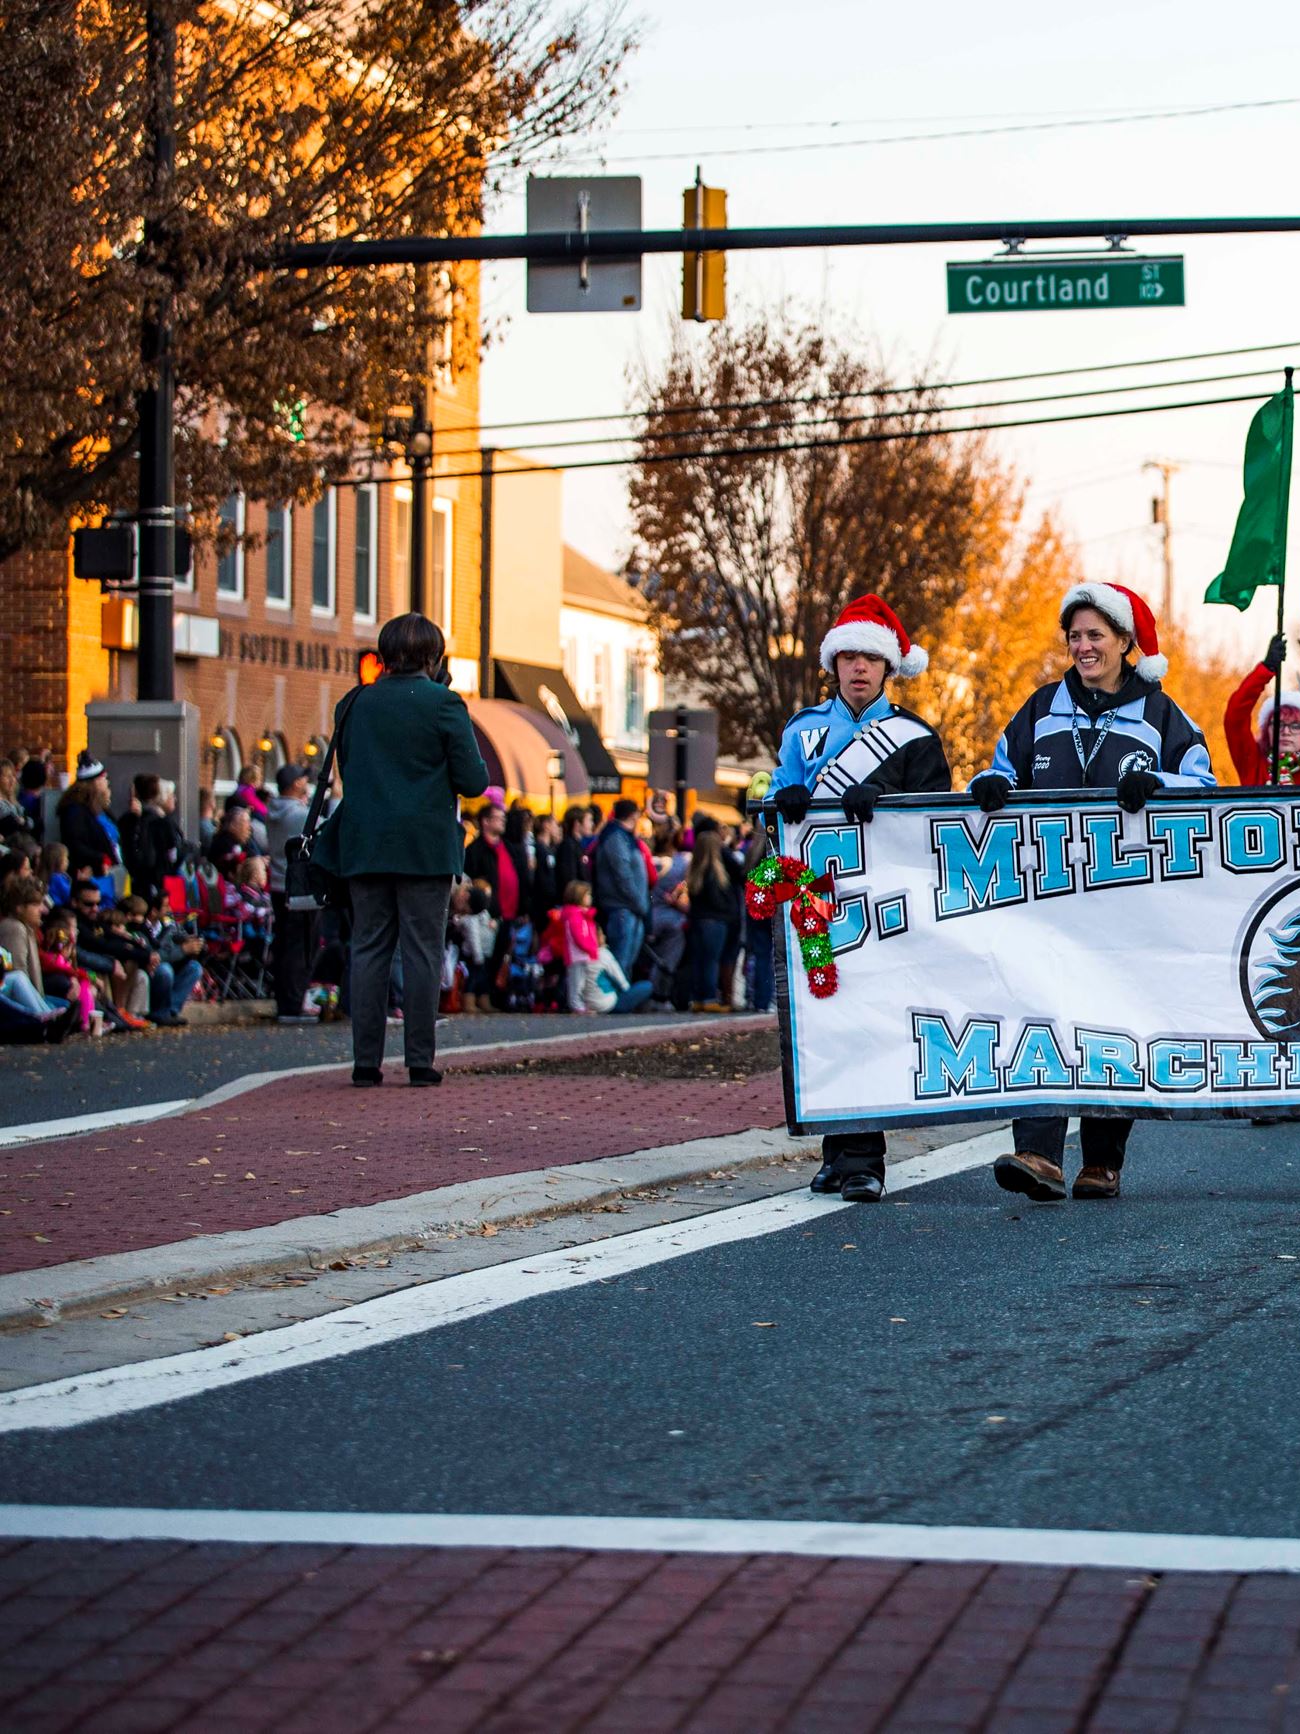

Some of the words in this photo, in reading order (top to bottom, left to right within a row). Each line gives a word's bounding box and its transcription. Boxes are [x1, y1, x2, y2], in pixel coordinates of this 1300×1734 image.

[1141, 262, 1161, 280] ST
[965, 272, 1110, 305] Courtland
[799, 725, 831, 761] W
[801, 821, 907, 956] C.
